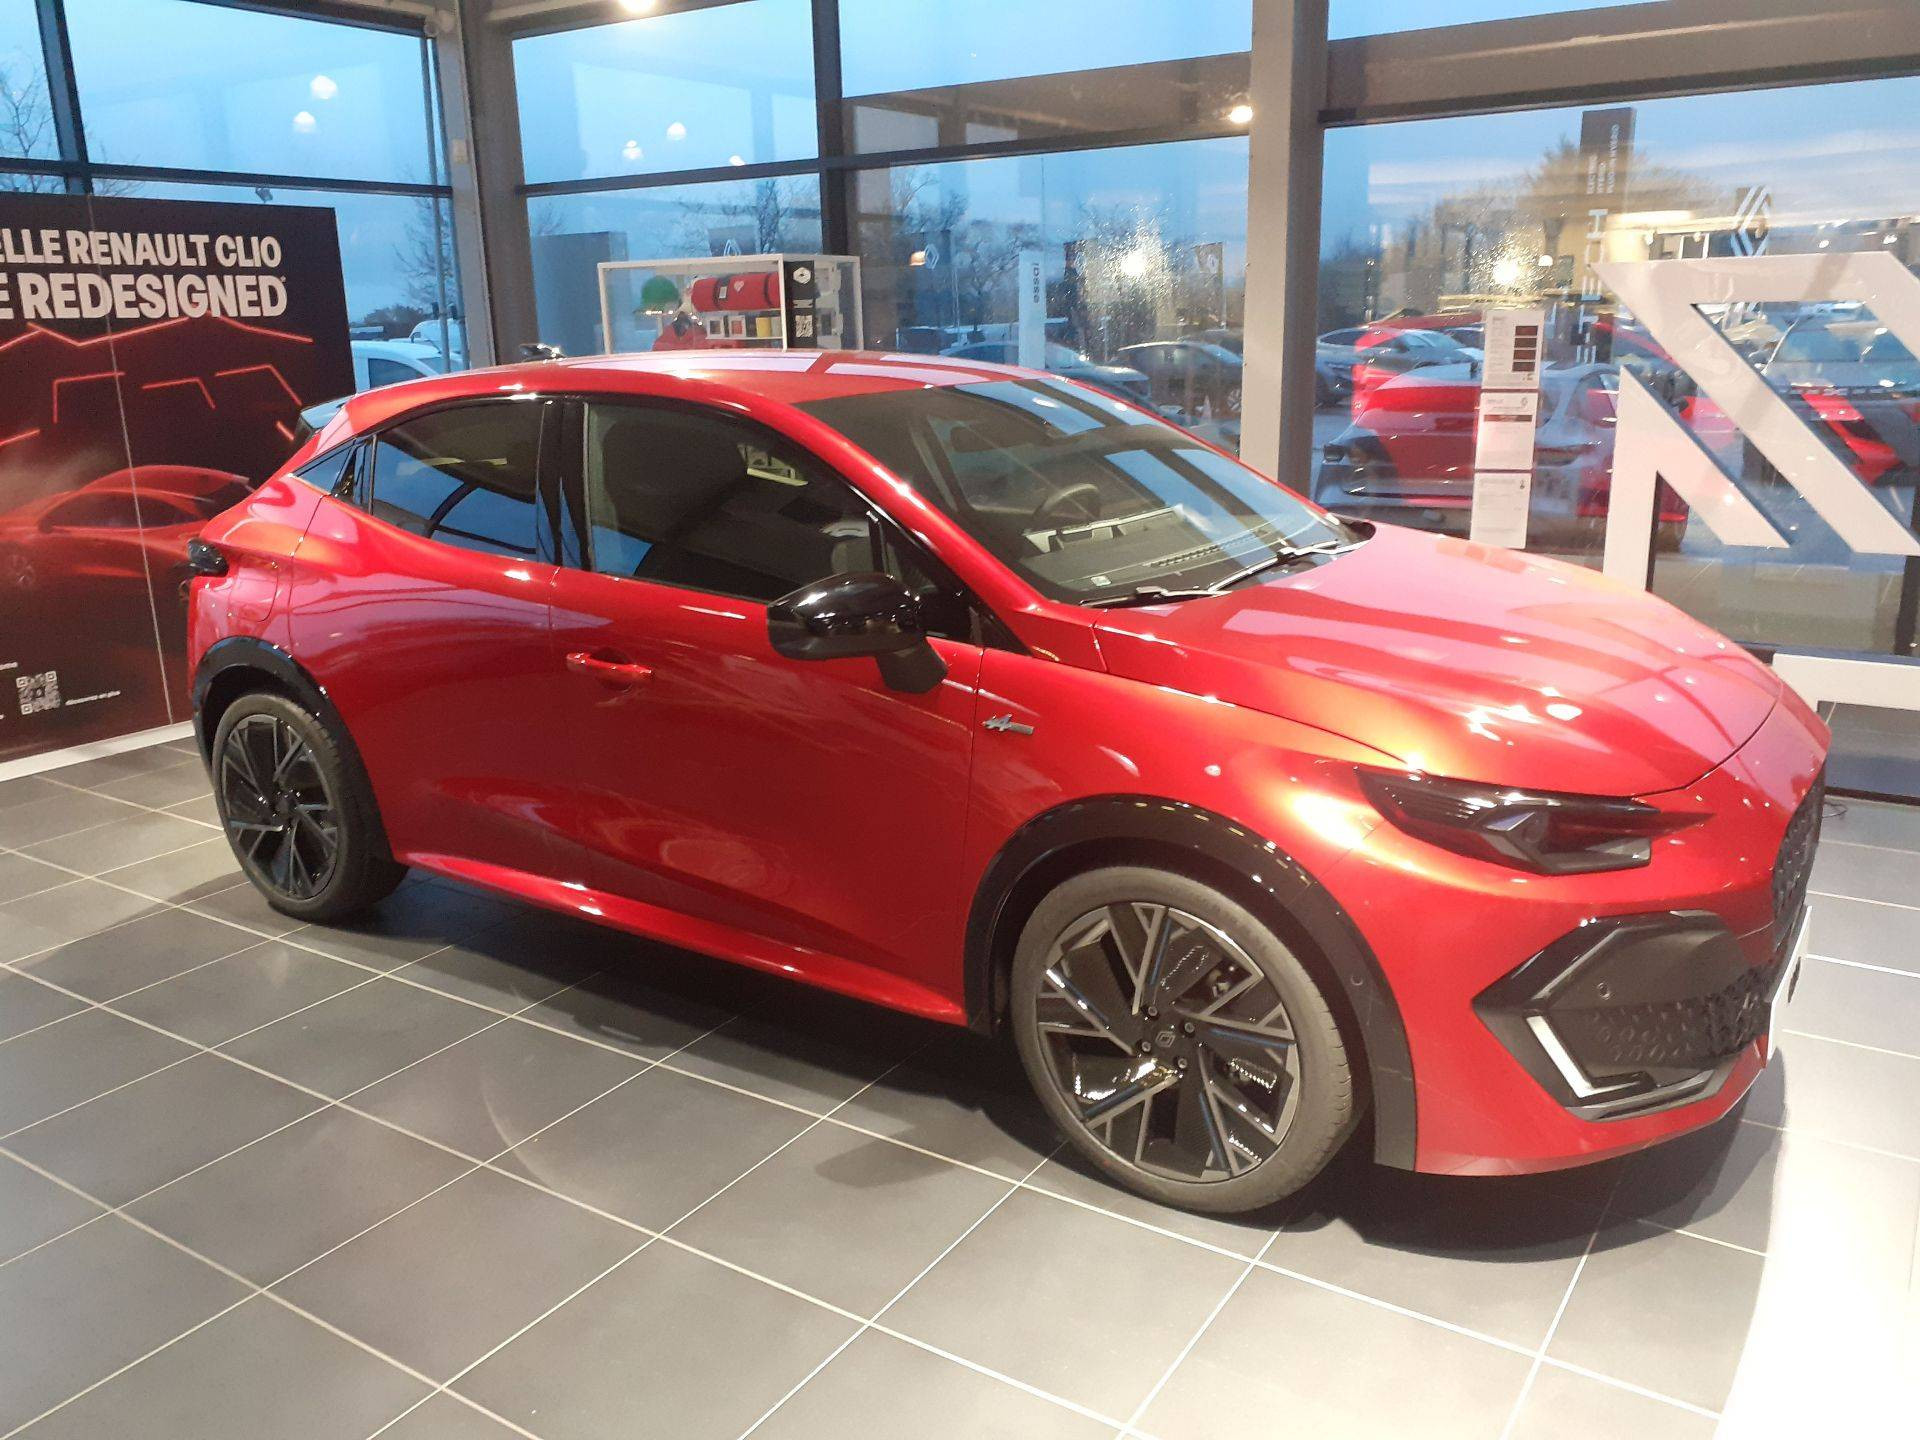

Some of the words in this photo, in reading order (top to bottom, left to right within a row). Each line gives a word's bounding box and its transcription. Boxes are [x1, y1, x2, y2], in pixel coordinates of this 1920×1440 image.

[0, 229, 64, 264] LLE
[66, 231, 209, 266] RENAULT
[215, 235, 282, 268] CLIO
